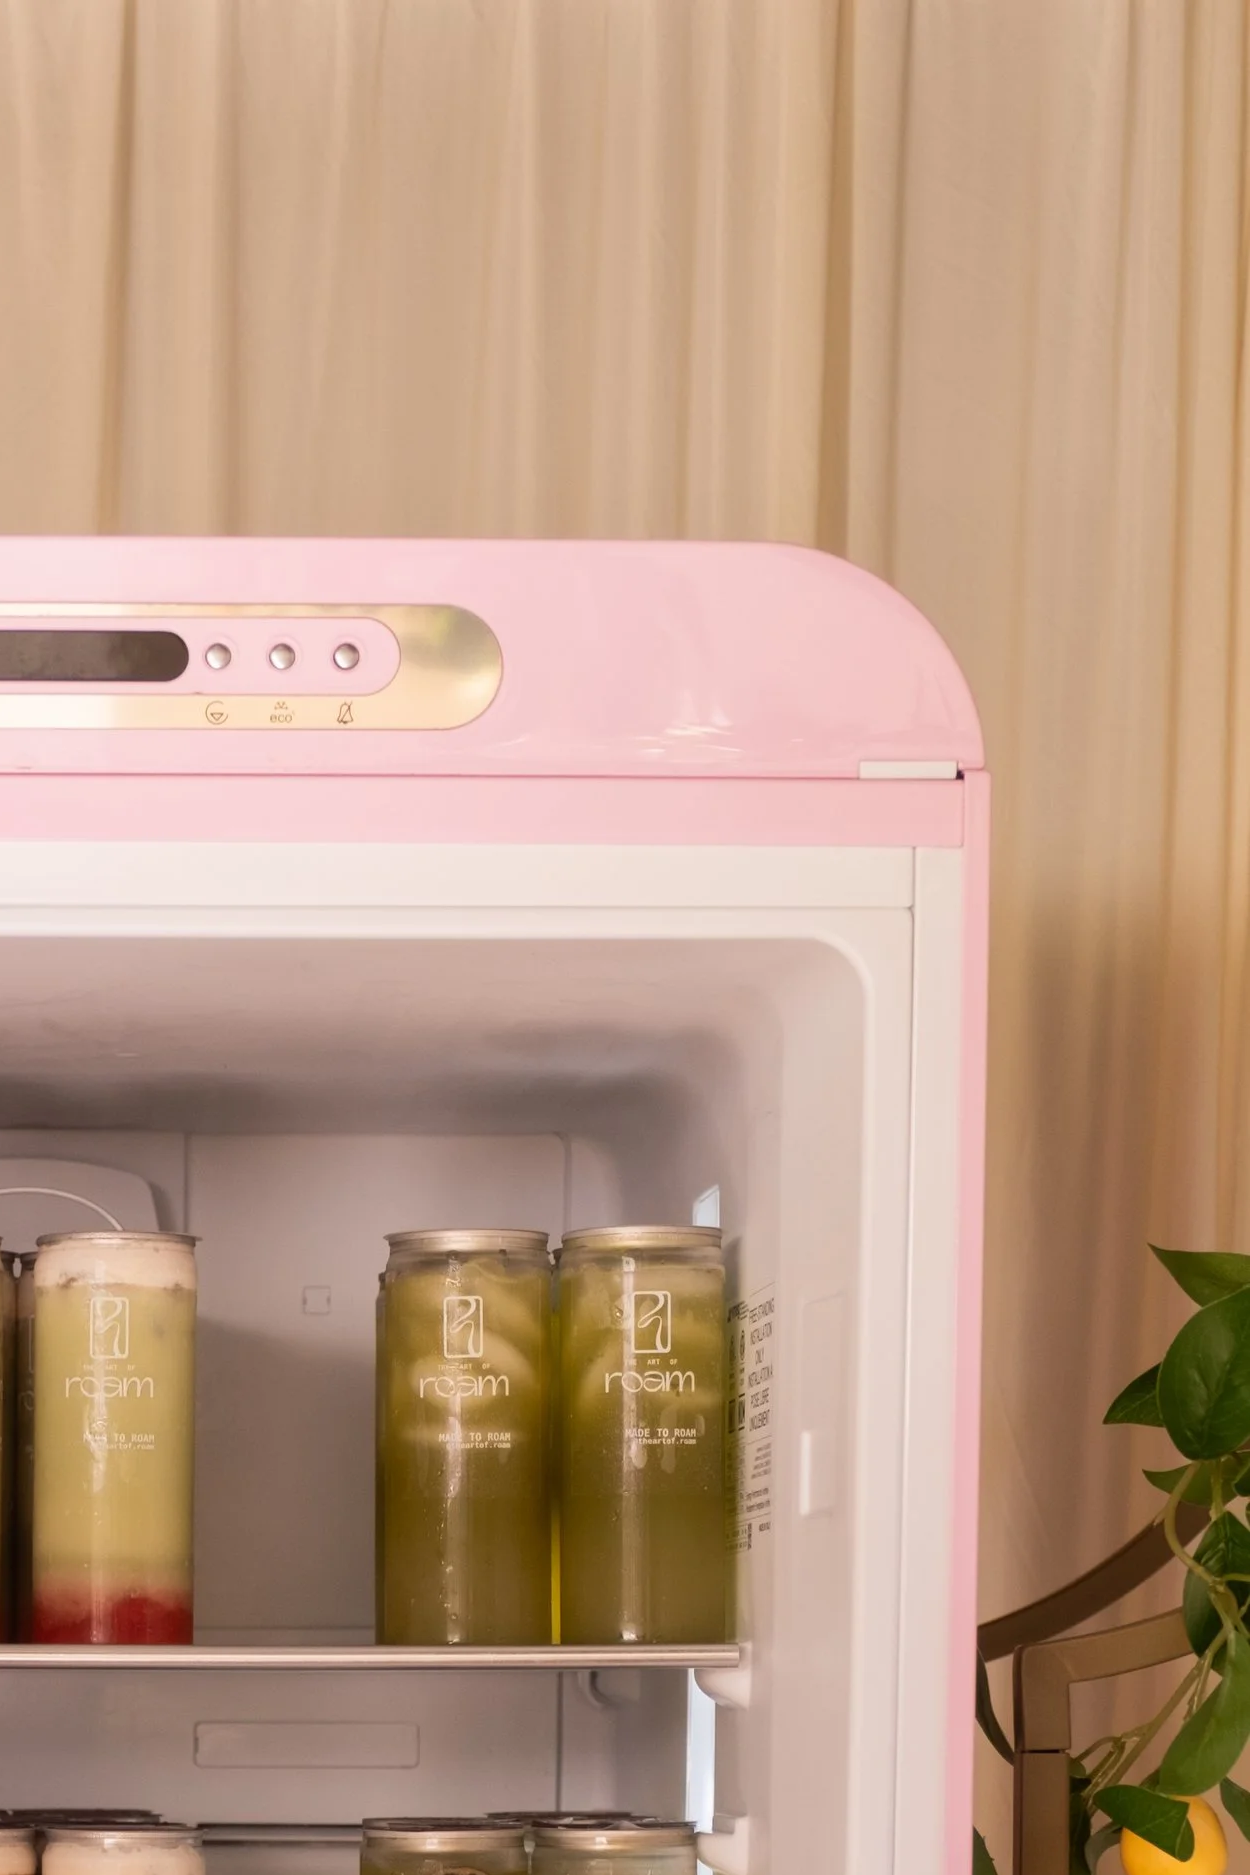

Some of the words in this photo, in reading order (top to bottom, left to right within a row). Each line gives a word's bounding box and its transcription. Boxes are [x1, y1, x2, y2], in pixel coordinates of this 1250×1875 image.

[269, 714, 293, 723] eco
[419, 1375, 510, 1398] roam
[605, 1370, 695, 1393] roam
[65, 1376, 154, 1398] roam
[469, 1433, 481, 1442] TO
[487, 1432, 511, 1441] ROAM
[625, 1428, 650, 1438] MADE
[656, 1428, 669, 1437] TO
[674, 1428, 697, 1437] ROAM
[132, 1434, 155, 1443] ROAM
